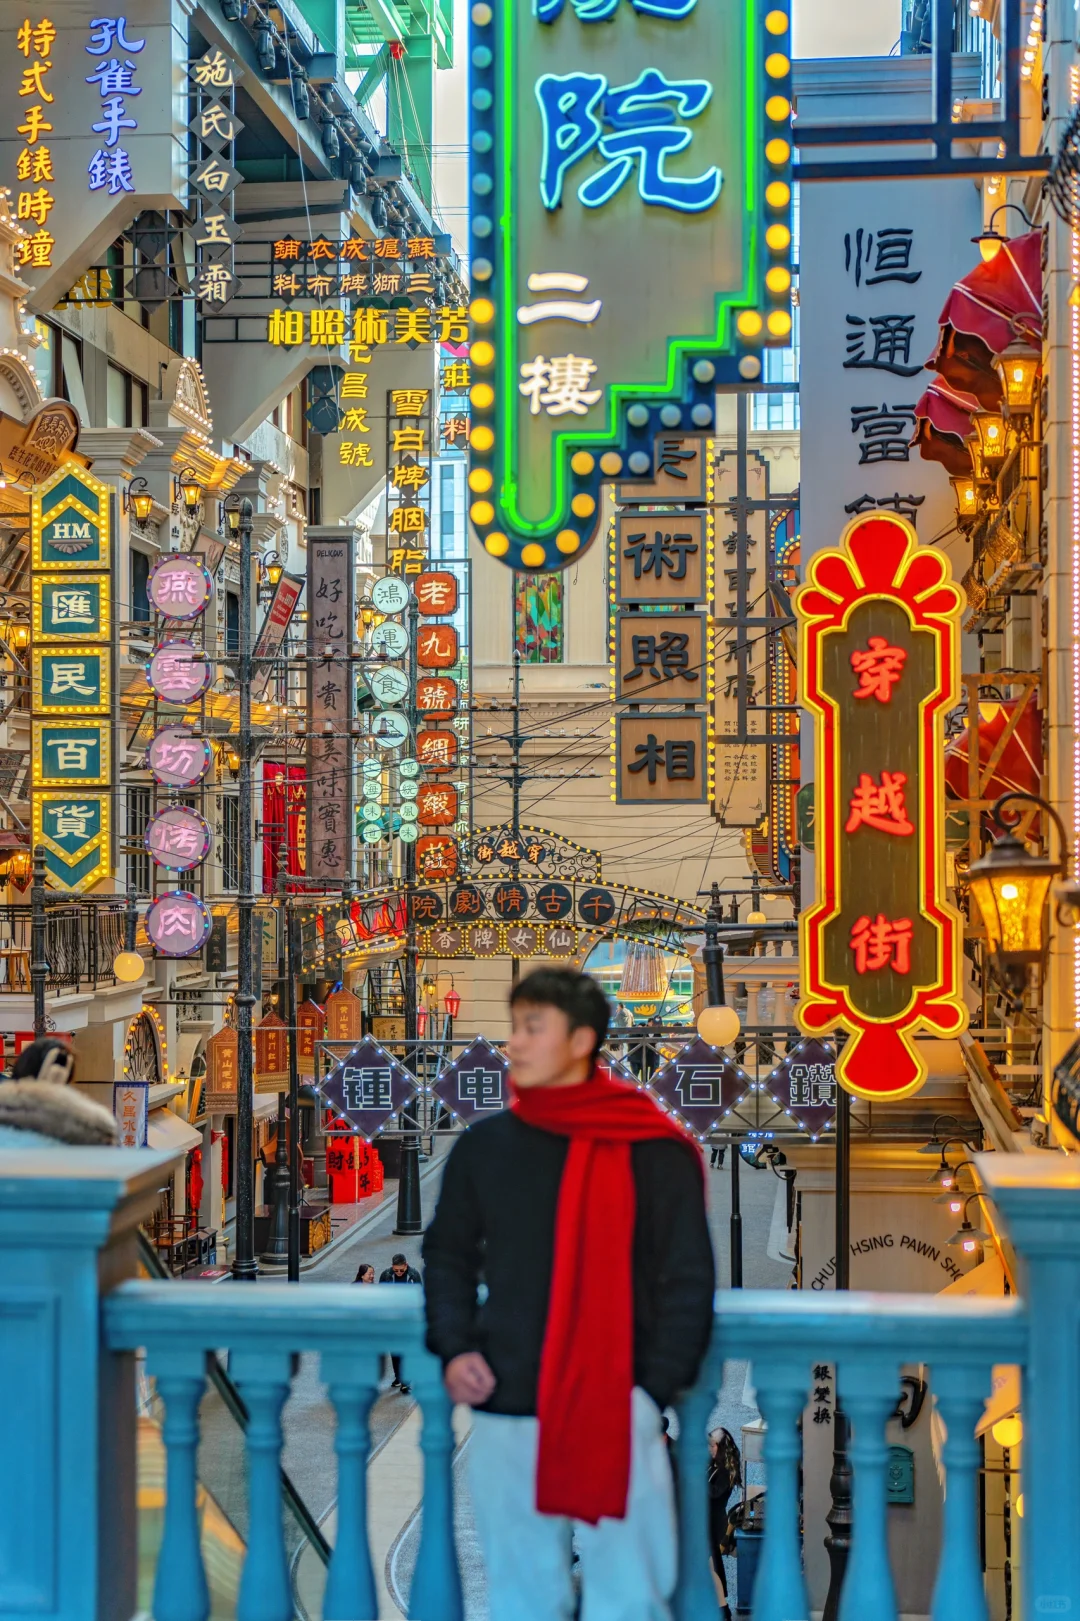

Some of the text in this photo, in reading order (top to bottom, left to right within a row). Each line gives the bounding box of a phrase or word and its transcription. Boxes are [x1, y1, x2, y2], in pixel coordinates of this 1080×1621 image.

[84, 16, 146, 195] 孔雀手錶
[194, 51, 235, 304] 施氏白玉霜
[516, 270, 602, 417] 二樓
[52, 522, 91, 539] HM
[391, 389, 431, 574] 雪白牌胭脂
[47, 590, 98, 839] 匯民百貨
[153, 568, 201, 942] 燕雲坊烤肉
[845, 635, 916, 977] 穿越街
[850, 1234, 894, 1256] HSING
[899, 1235, 940, 1262] PAWN
